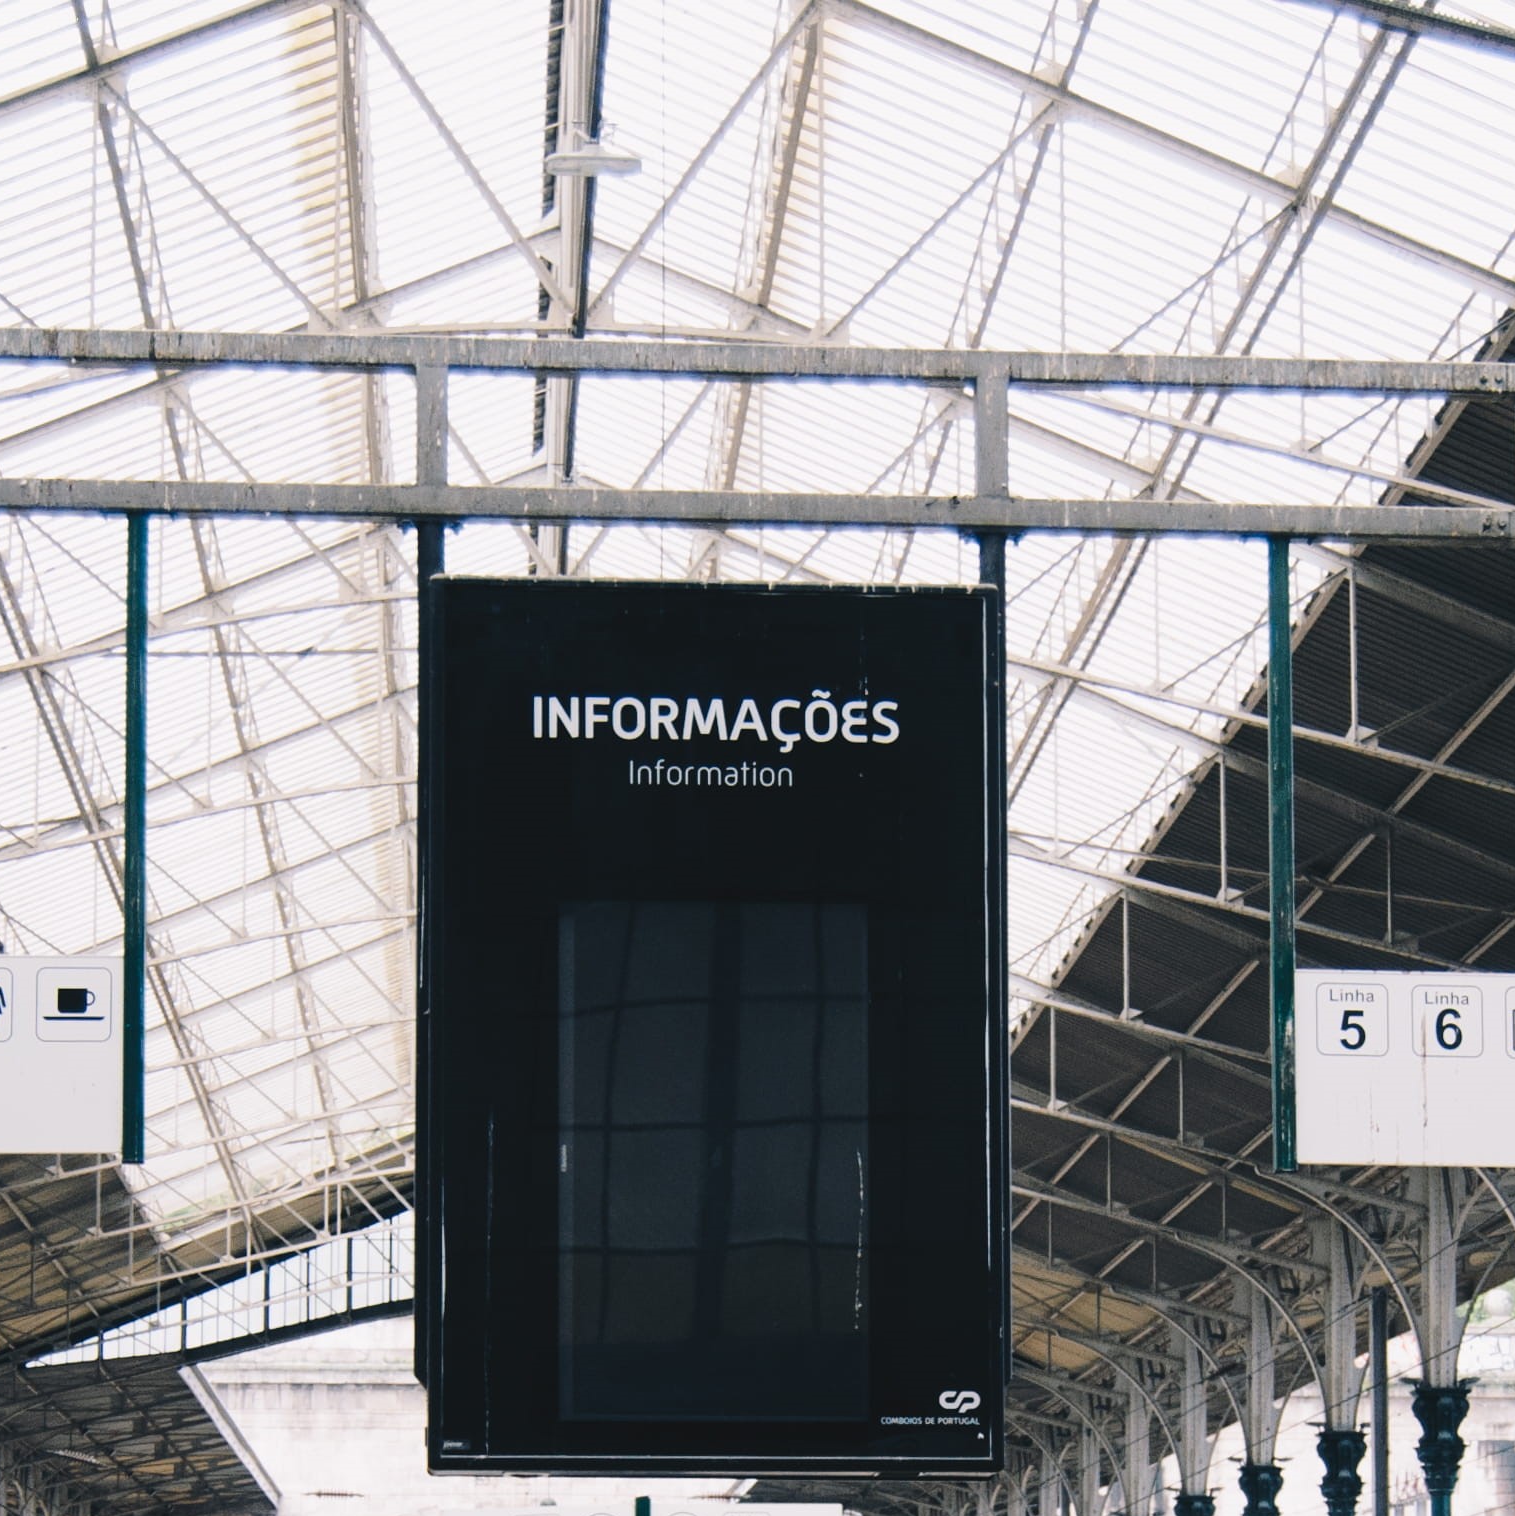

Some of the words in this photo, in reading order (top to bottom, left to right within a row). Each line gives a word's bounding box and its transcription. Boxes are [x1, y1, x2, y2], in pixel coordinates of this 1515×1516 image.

[533, 690, 900, 754] INFORMAÇÕES
[629, 757, 794, 788] Information
[1329, 988, 1376, 1003] Linha
[1424, 991, 1470, 1006] Linha
[1340, 1009, 1367, 1051] 5
[1435, 1008, 1463, 1050] 6
[937, 1416, 980, 1426] PORTUGAL
